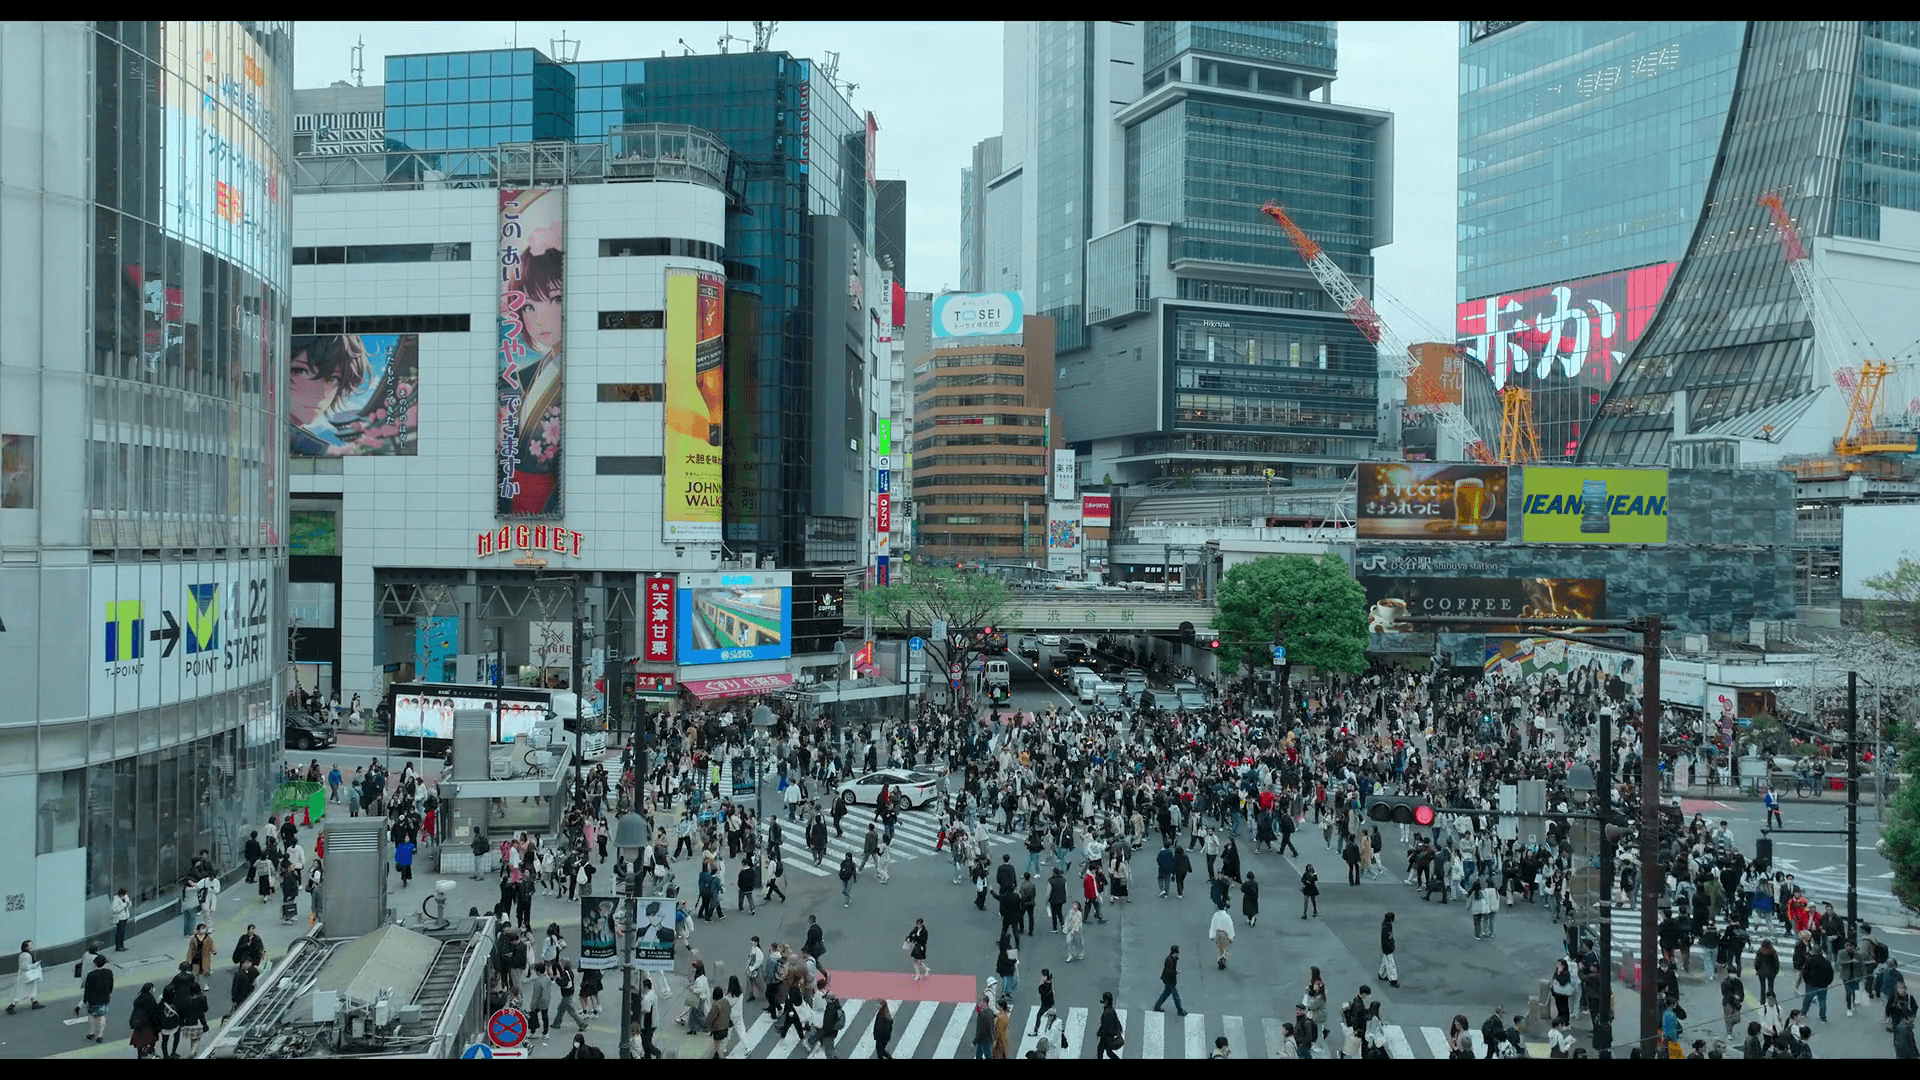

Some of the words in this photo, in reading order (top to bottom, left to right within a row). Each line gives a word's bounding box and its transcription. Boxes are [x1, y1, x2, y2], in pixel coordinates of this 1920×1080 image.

[954, 309, 1000, 321] TOSEI
[954, 321, 1000, 330] トーセイ株式会社
[1203, 320, 1230, 328] Hikarie
[1365, 502, 1440, 515] きょうれつに
[478, 524, 584, 559] MAGNET
[1362, 556, 1387, 570] JR
[1391, 557, 1432, 570] 渋谷駅
[1434, 562, 1468, 573] shibuya
[1469, 562, 1498, 571] station
[651, 583, 670, 591] 名物
[1423, 598, 1512, 610] COFFEE
[1047, 609, 1135, 622] 渋谷駅
[651, 592, 669, 655] 天津甘栗
[224, 632, 268, 671] START
[105, 664, 144, 678] T-POINT
[186, 657, 219, 678] POINT
[639, 677, 673, 685] 天津栗
[705, 679, 741, 691] くすり
[743, 675, 788, 688] 化粧品
